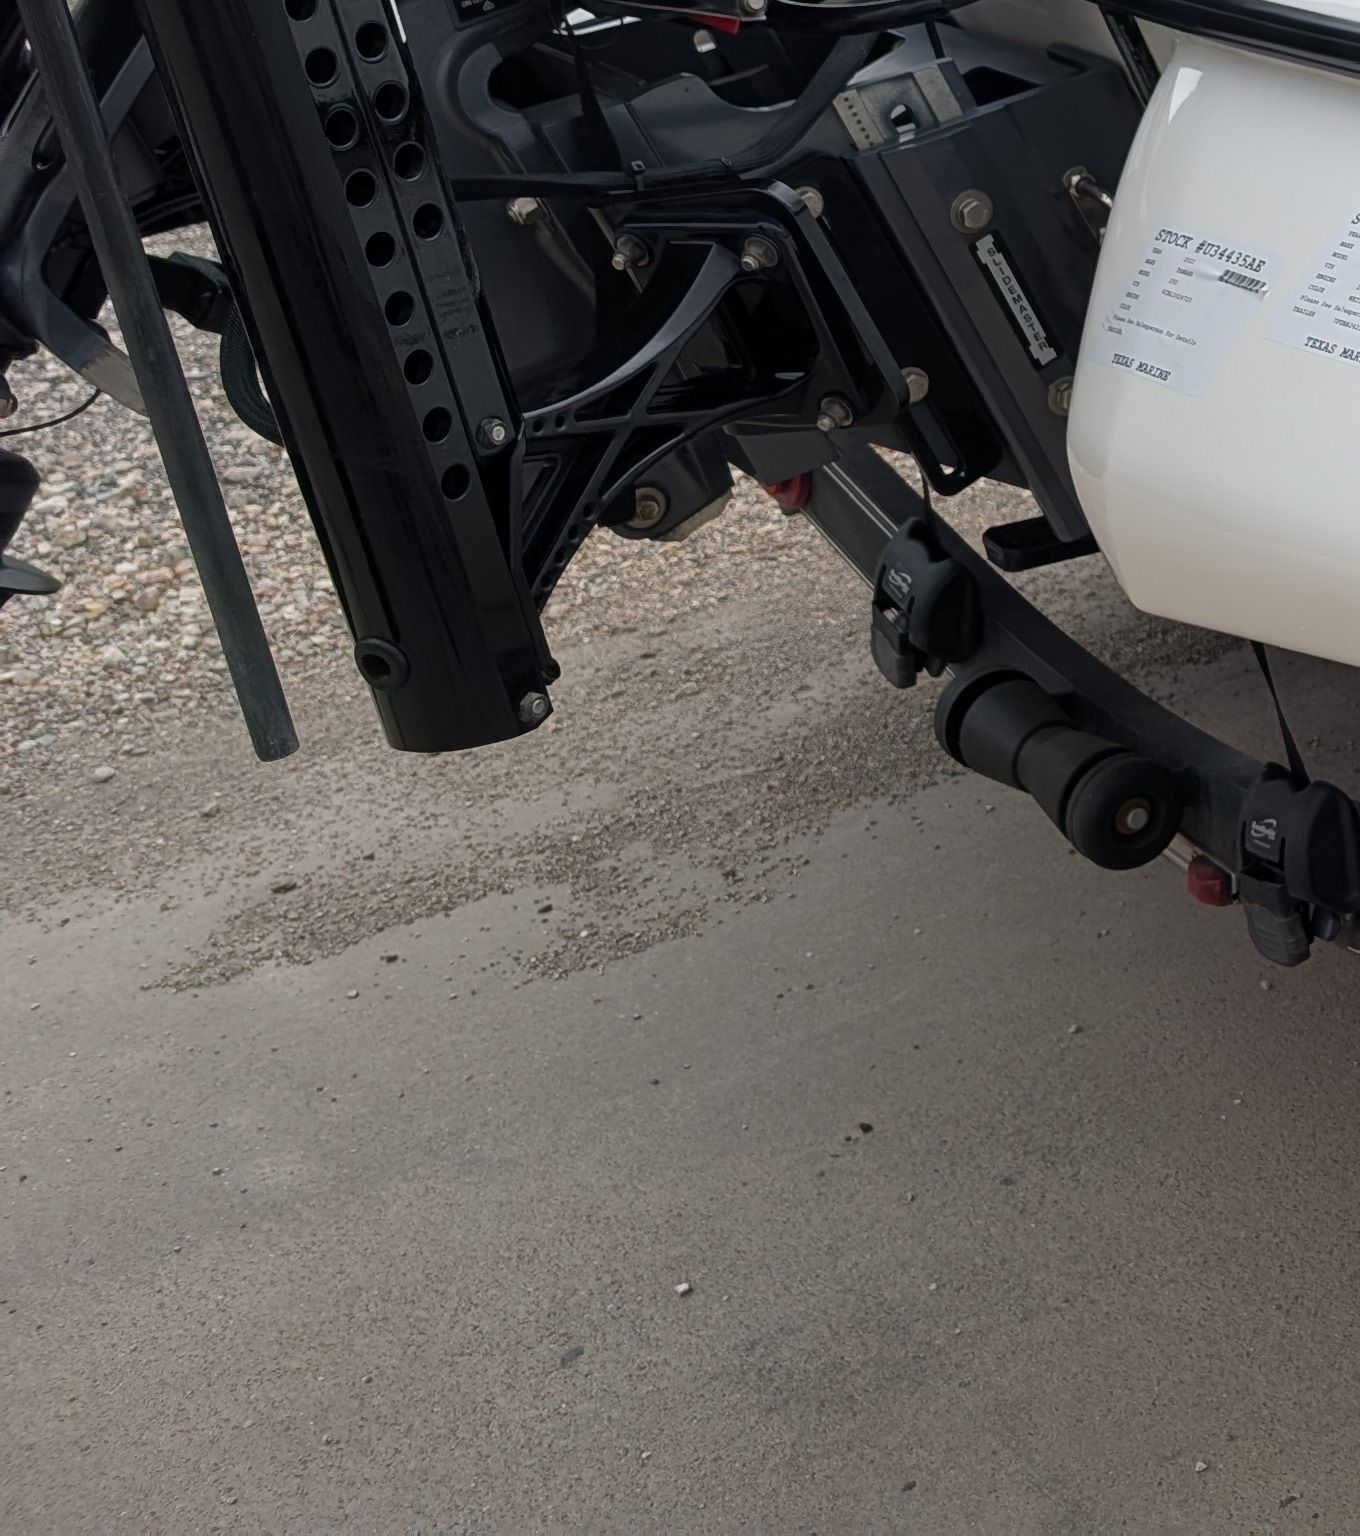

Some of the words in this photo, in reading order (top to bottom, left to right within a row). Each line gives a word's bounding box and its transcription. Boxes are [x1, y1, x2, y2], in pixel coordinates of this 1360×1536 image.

[1154, 229, 1194, 249] STOCK
[1195, 240, 1266, 273] #U34435AE
[987, 247, 1049, 352] SLIDEMASTER
[1304, 336, 1338, 354] TEXAS
[1135, 359, 1171, 381] MARINE
